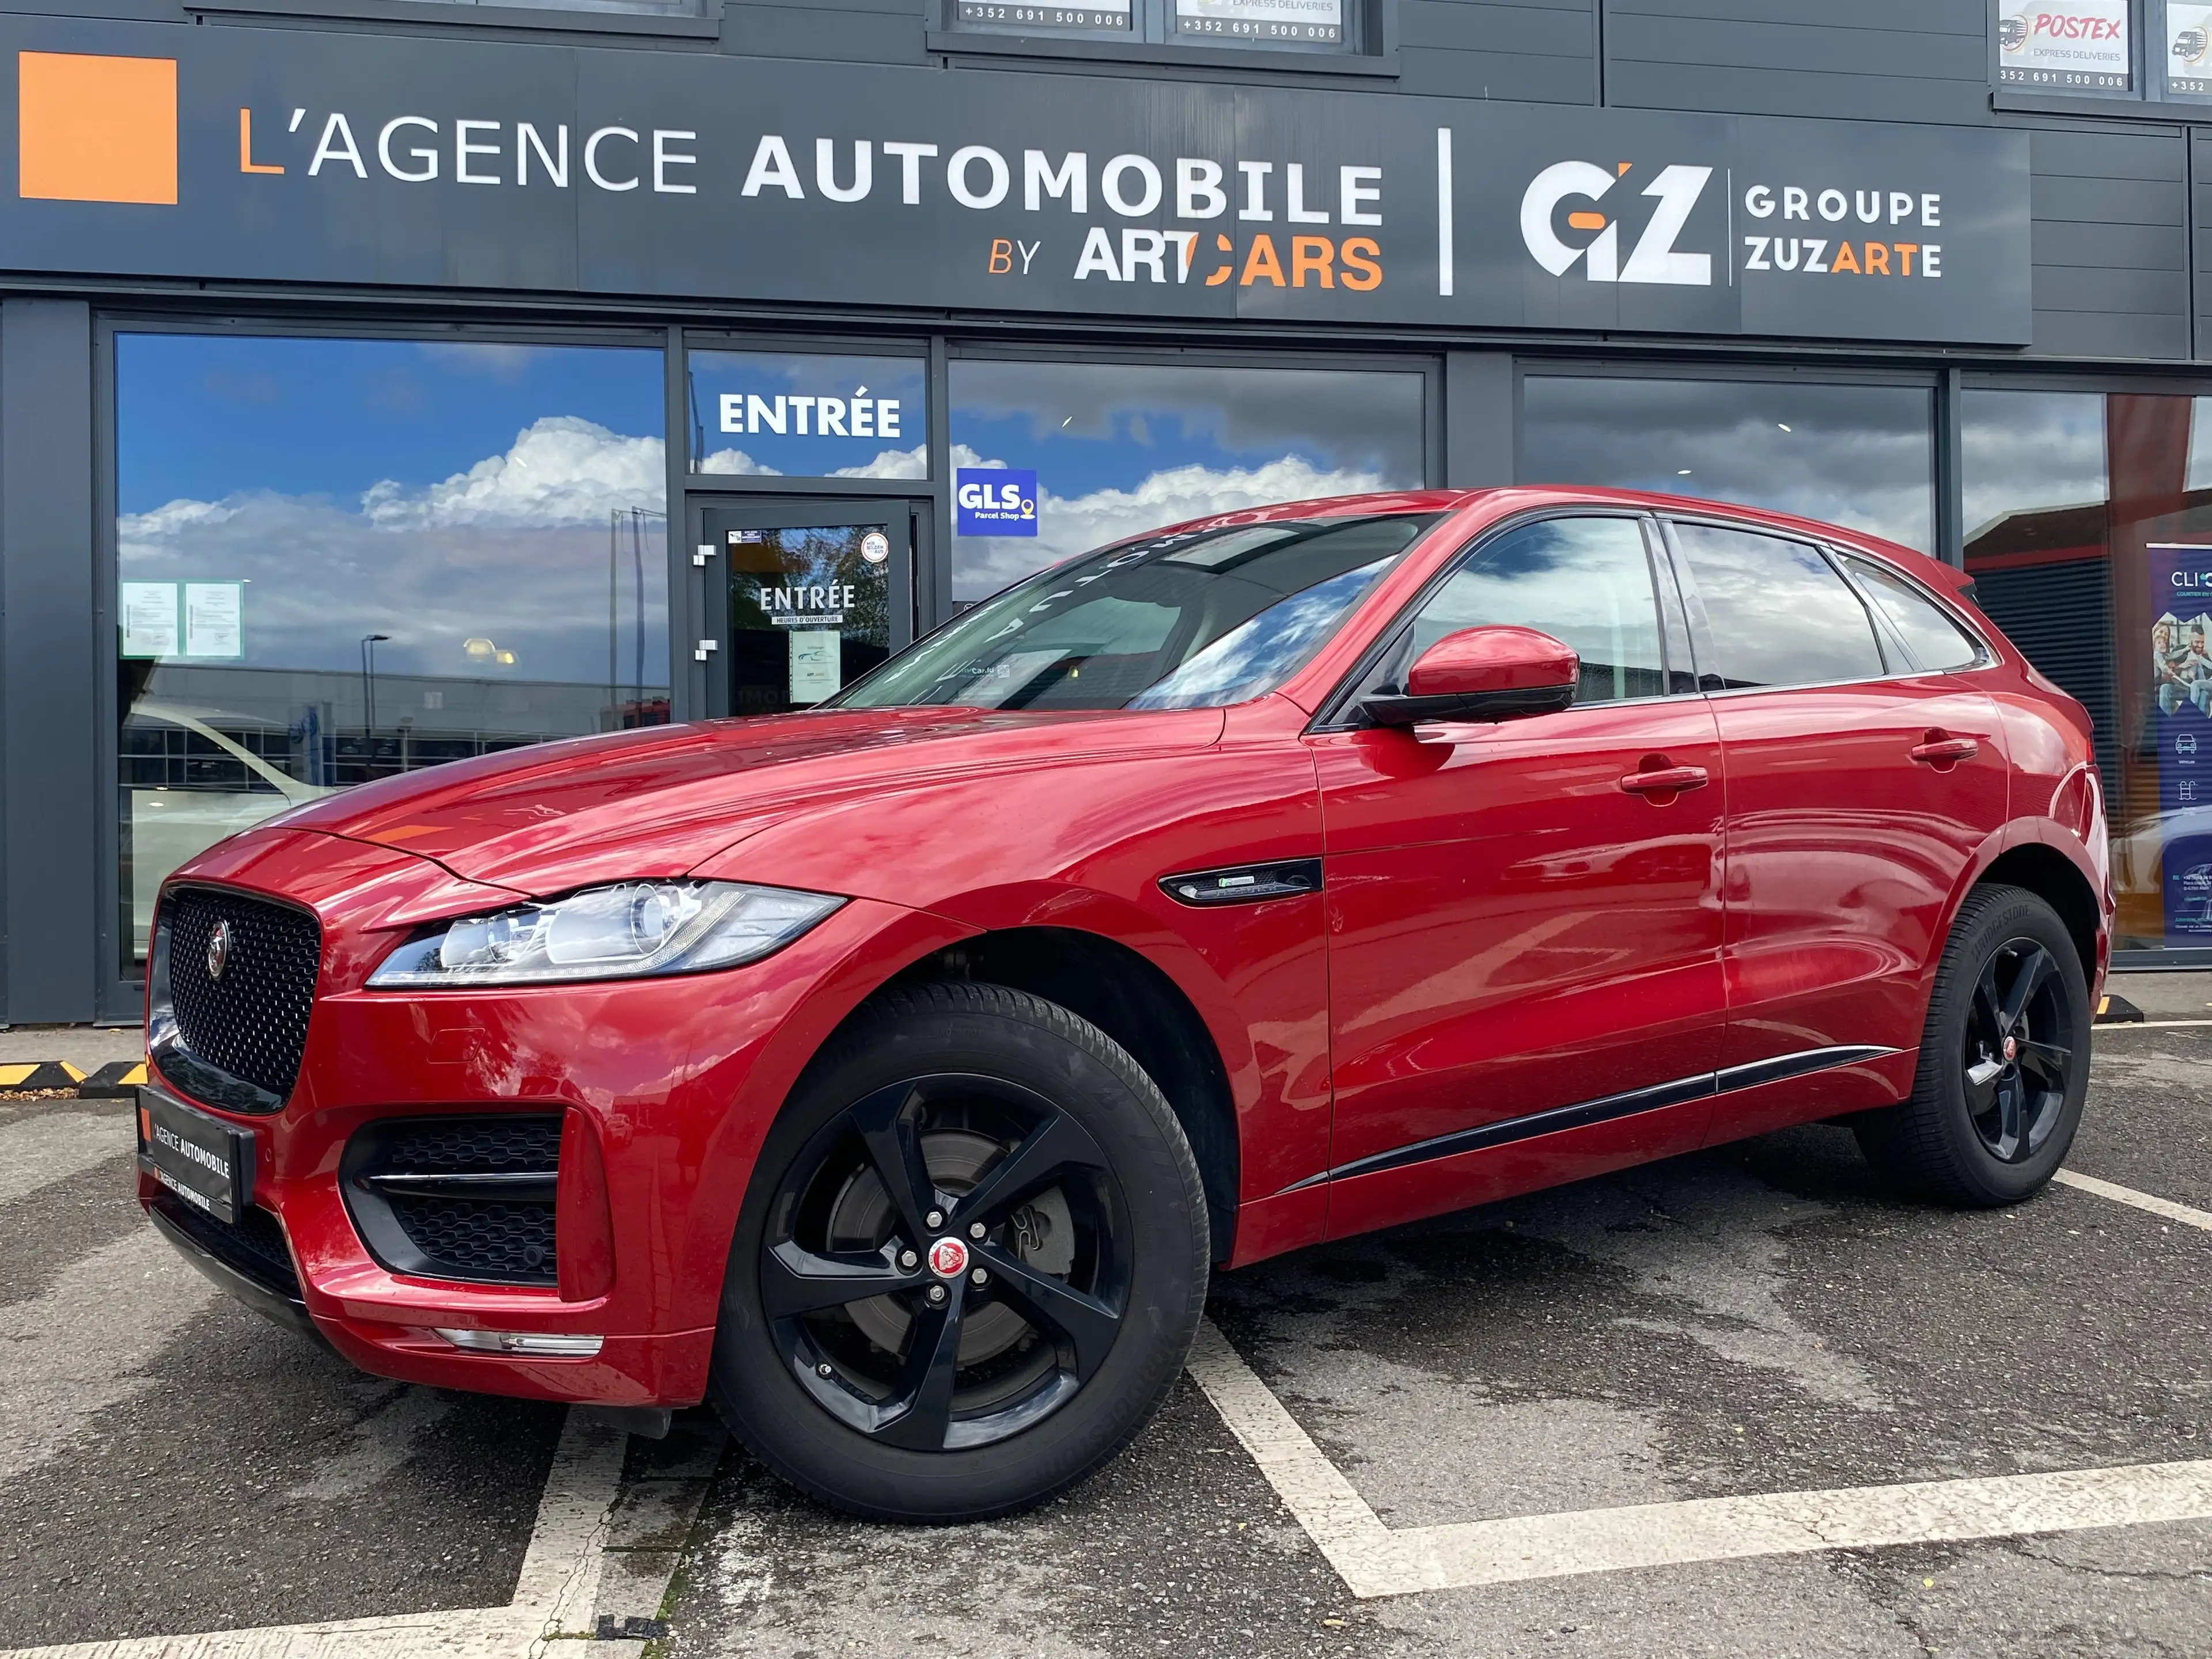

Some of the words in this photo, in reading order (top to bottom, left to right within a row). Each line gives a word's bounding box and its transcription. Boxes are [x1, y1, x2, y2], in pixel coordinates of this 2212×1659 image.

[965, 7, 1005, 19] +352
[1016, 10, 1044, 21] 691
[1056, 12, 1085, 24] 500
[1095, 14, 1123, 26] 006
[1278, 0, 1333, 11] DELIVERIES
[1184, 20, 1222, 32] +352
[1232, 22, 1259, 34] 691
[1271, 25, 1298, 36] 500
[1308, 27, 1335, 38] 006
[2033, 13, 2120, 40] POSTEX
[2033, 48, 2071, 58] EXPRESS
[2073, 52, 2121, 62] DELIVERIES
[2033, 72, 2057, 83] 691
[2066, 74, 2090, 85] 500
[2099, 76, 2123, 86] 006
[2172, 81, 2205, 92] +352
[240, 107, 697, 195] L'AGENCE
[741, 135, 1382, 227] AUTOMOBILE
[1745, 184, 1941, 228] GROUPE
[988, 238, 1041, 275] BY
[1744, 236, 1942, 278] ZUZARTE
[719, 385, 900, 438] ENTRÉE
[958, 483, 1021, 510] GLS
[975, 512, 999, 520] Parcel
[1001, 512, 1020, 521] Shop
[760, 579, 855, 610] ENTRÉE
[180, 1138, 230, 1179] AUTOMOBILE
[177, 1182, 210, 1211] AUTOMOBILE
